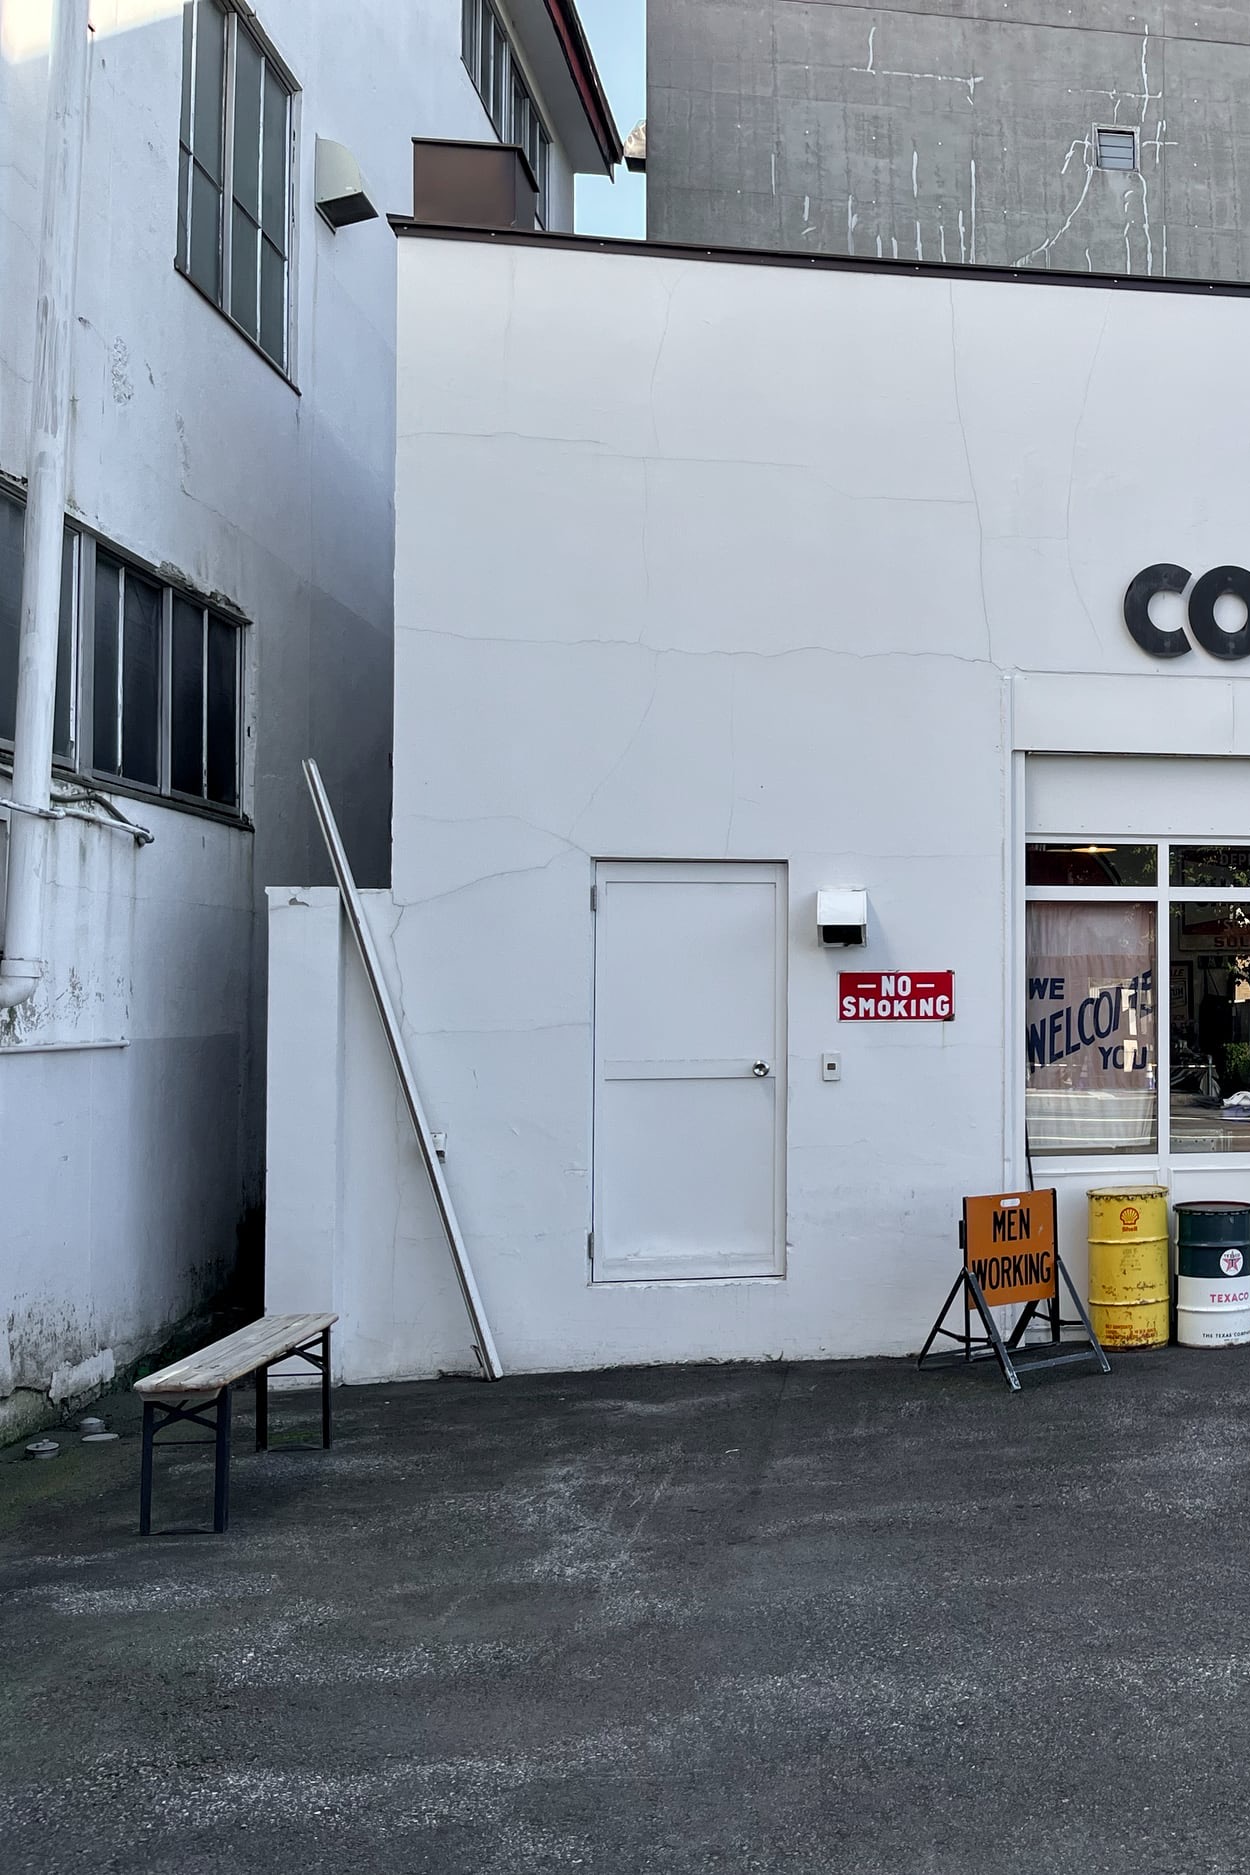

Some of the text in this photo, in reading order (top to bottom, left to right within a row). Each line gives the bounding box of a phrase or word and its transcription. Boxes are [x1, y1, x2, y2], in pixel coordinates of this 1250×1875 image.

[881, 975, 912, 997] NO
[1029, 977, 1065, 1000] WE
[842, 995, 950, 1018] SMOKING
[1098, 1045, 1148, 1070] YOU
[992, 1208, 1031, 1243] MEN
[972, 1251, 1051, 1291] WORKING
[1210, 1292, 1249, 1303] TEXACO
